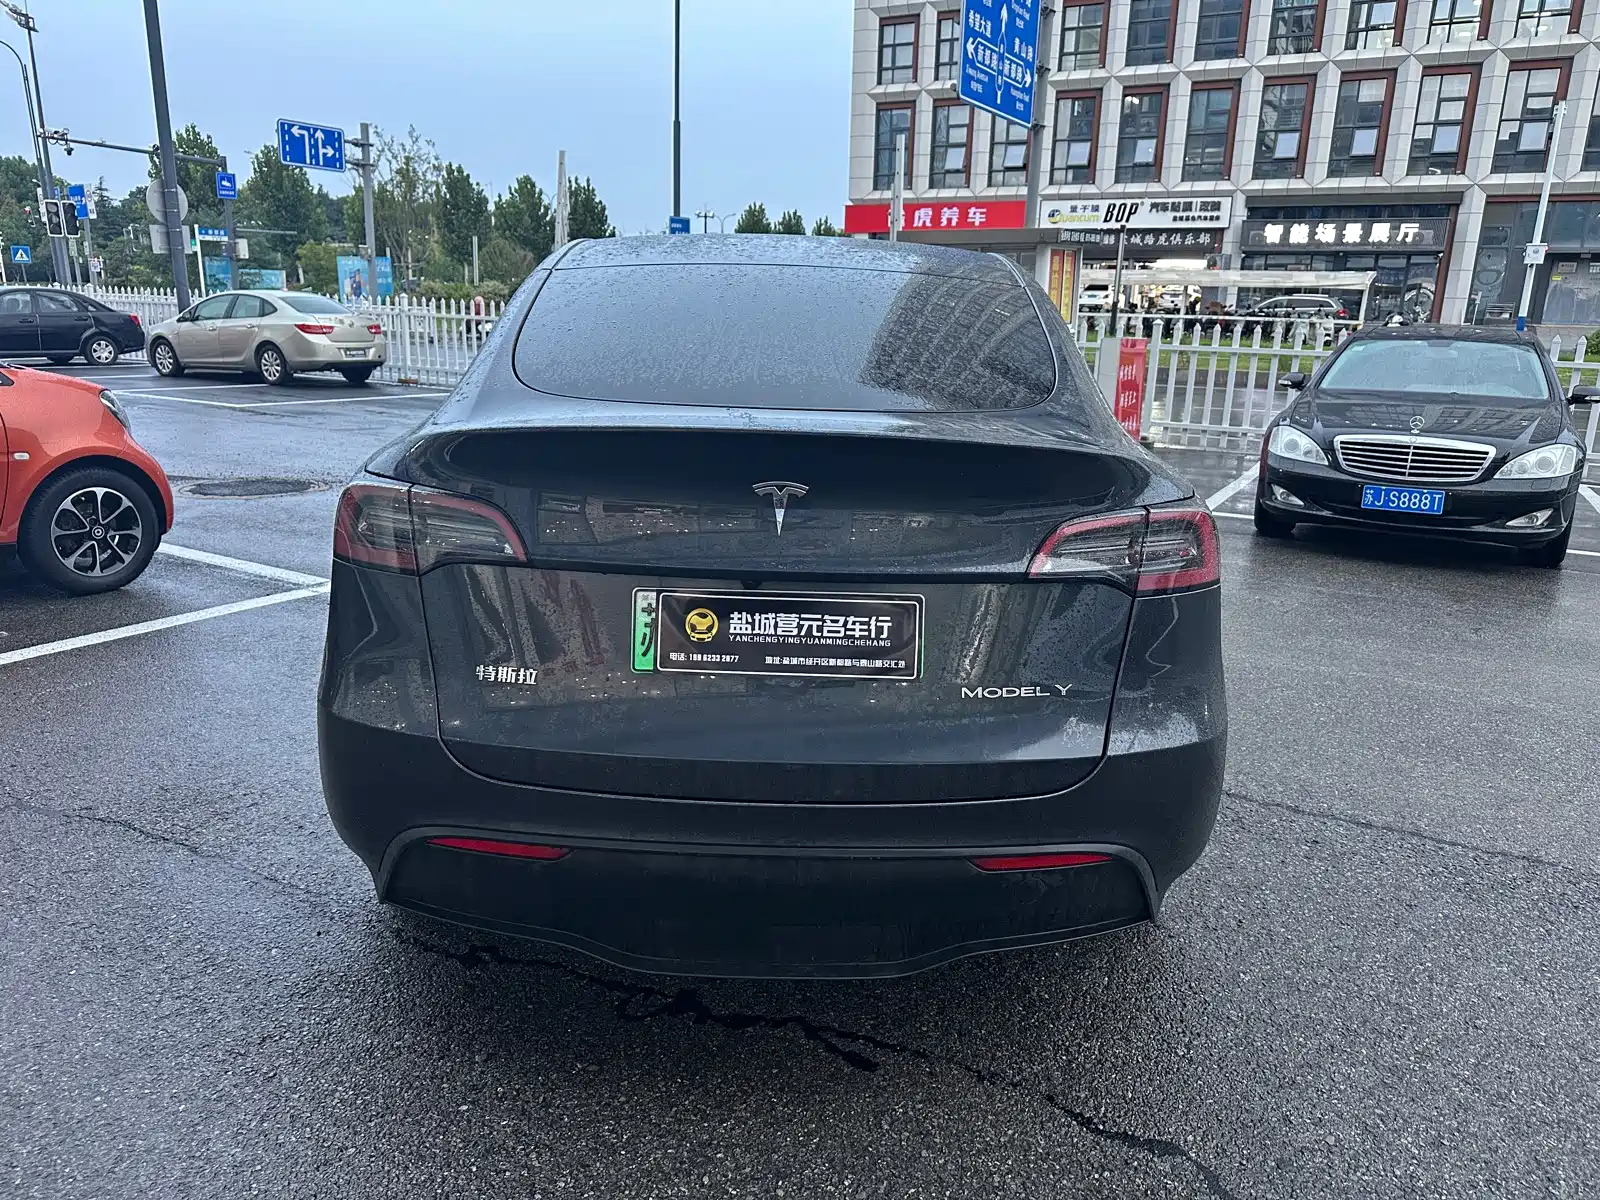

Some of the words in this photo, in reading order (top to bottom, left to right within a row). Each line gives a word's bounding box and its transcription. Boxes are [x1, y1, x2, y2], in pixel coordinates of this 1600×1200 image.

[968, 9, 992, 38] 希望大道
[1069, 204, 1100, 213] 量子膜
[1103, 202, 1140, 223] BOP
[1263, 222, 1420, 244] 智能场景展厅
[729, 611, 893, 640] 盐城营元名车行
[729, 634, 891, 647] YANCHENGYINGYUANMINGCHEHANG
[475, 664, 538, 685] 特斯拉
[961, 686, 1051, 699] MODEL
[1054, 683, 1073, 696] Y
